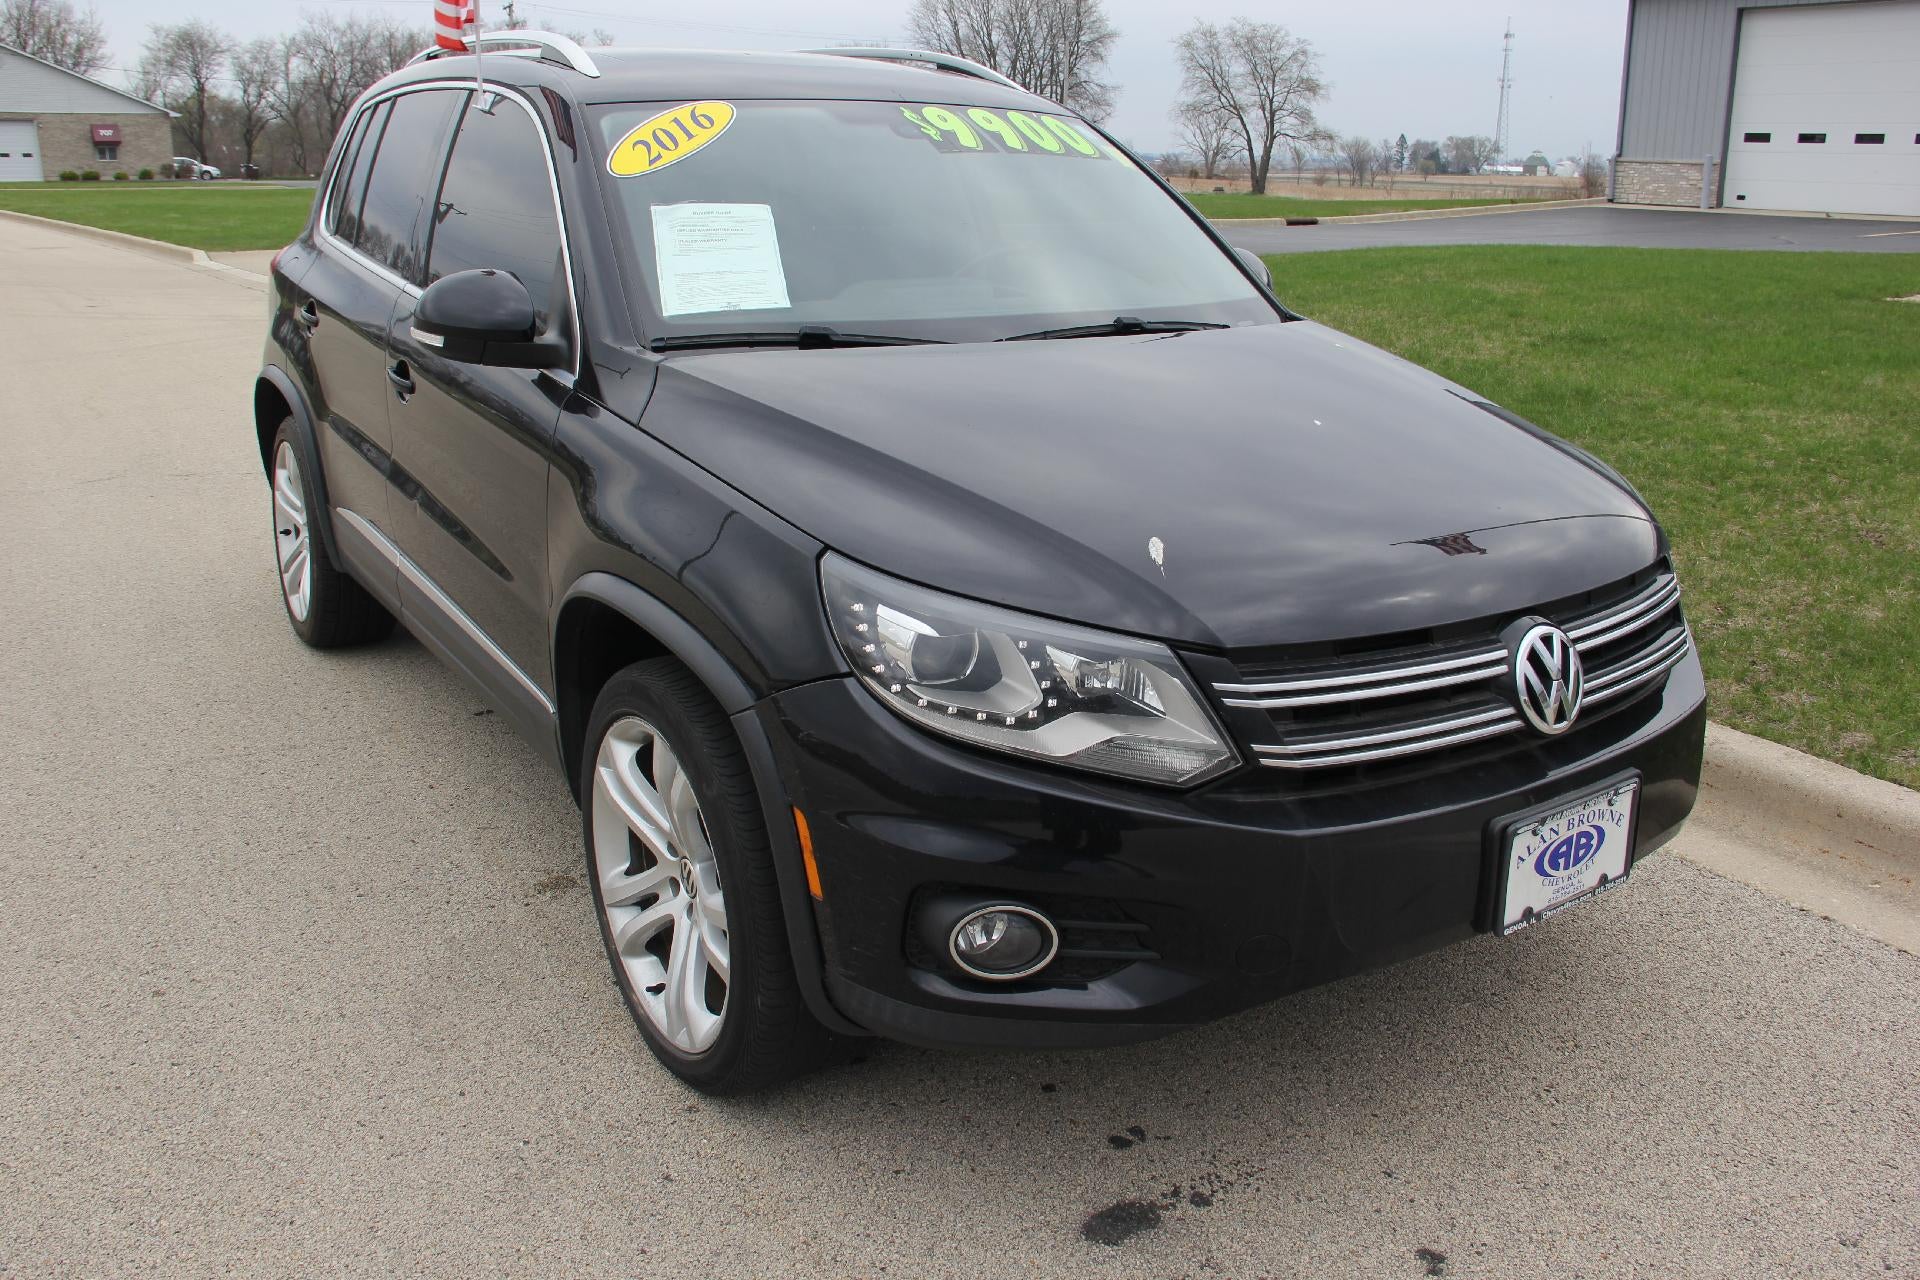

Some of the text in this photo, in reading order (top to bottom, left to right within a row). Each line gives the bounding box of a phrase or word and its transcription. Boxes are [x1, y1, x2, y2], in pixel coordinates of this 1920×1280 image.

[632, 106, 715, 166] 2016
[900, 106, 1099, 158] $9900
[1516, 824, 1561, 870] ALAN
[1566, 808, 1625, 829] BROWNE
[1547, 830, 1595, 872] AB
[1541, 858, 1596, 888] CHEVROLET
